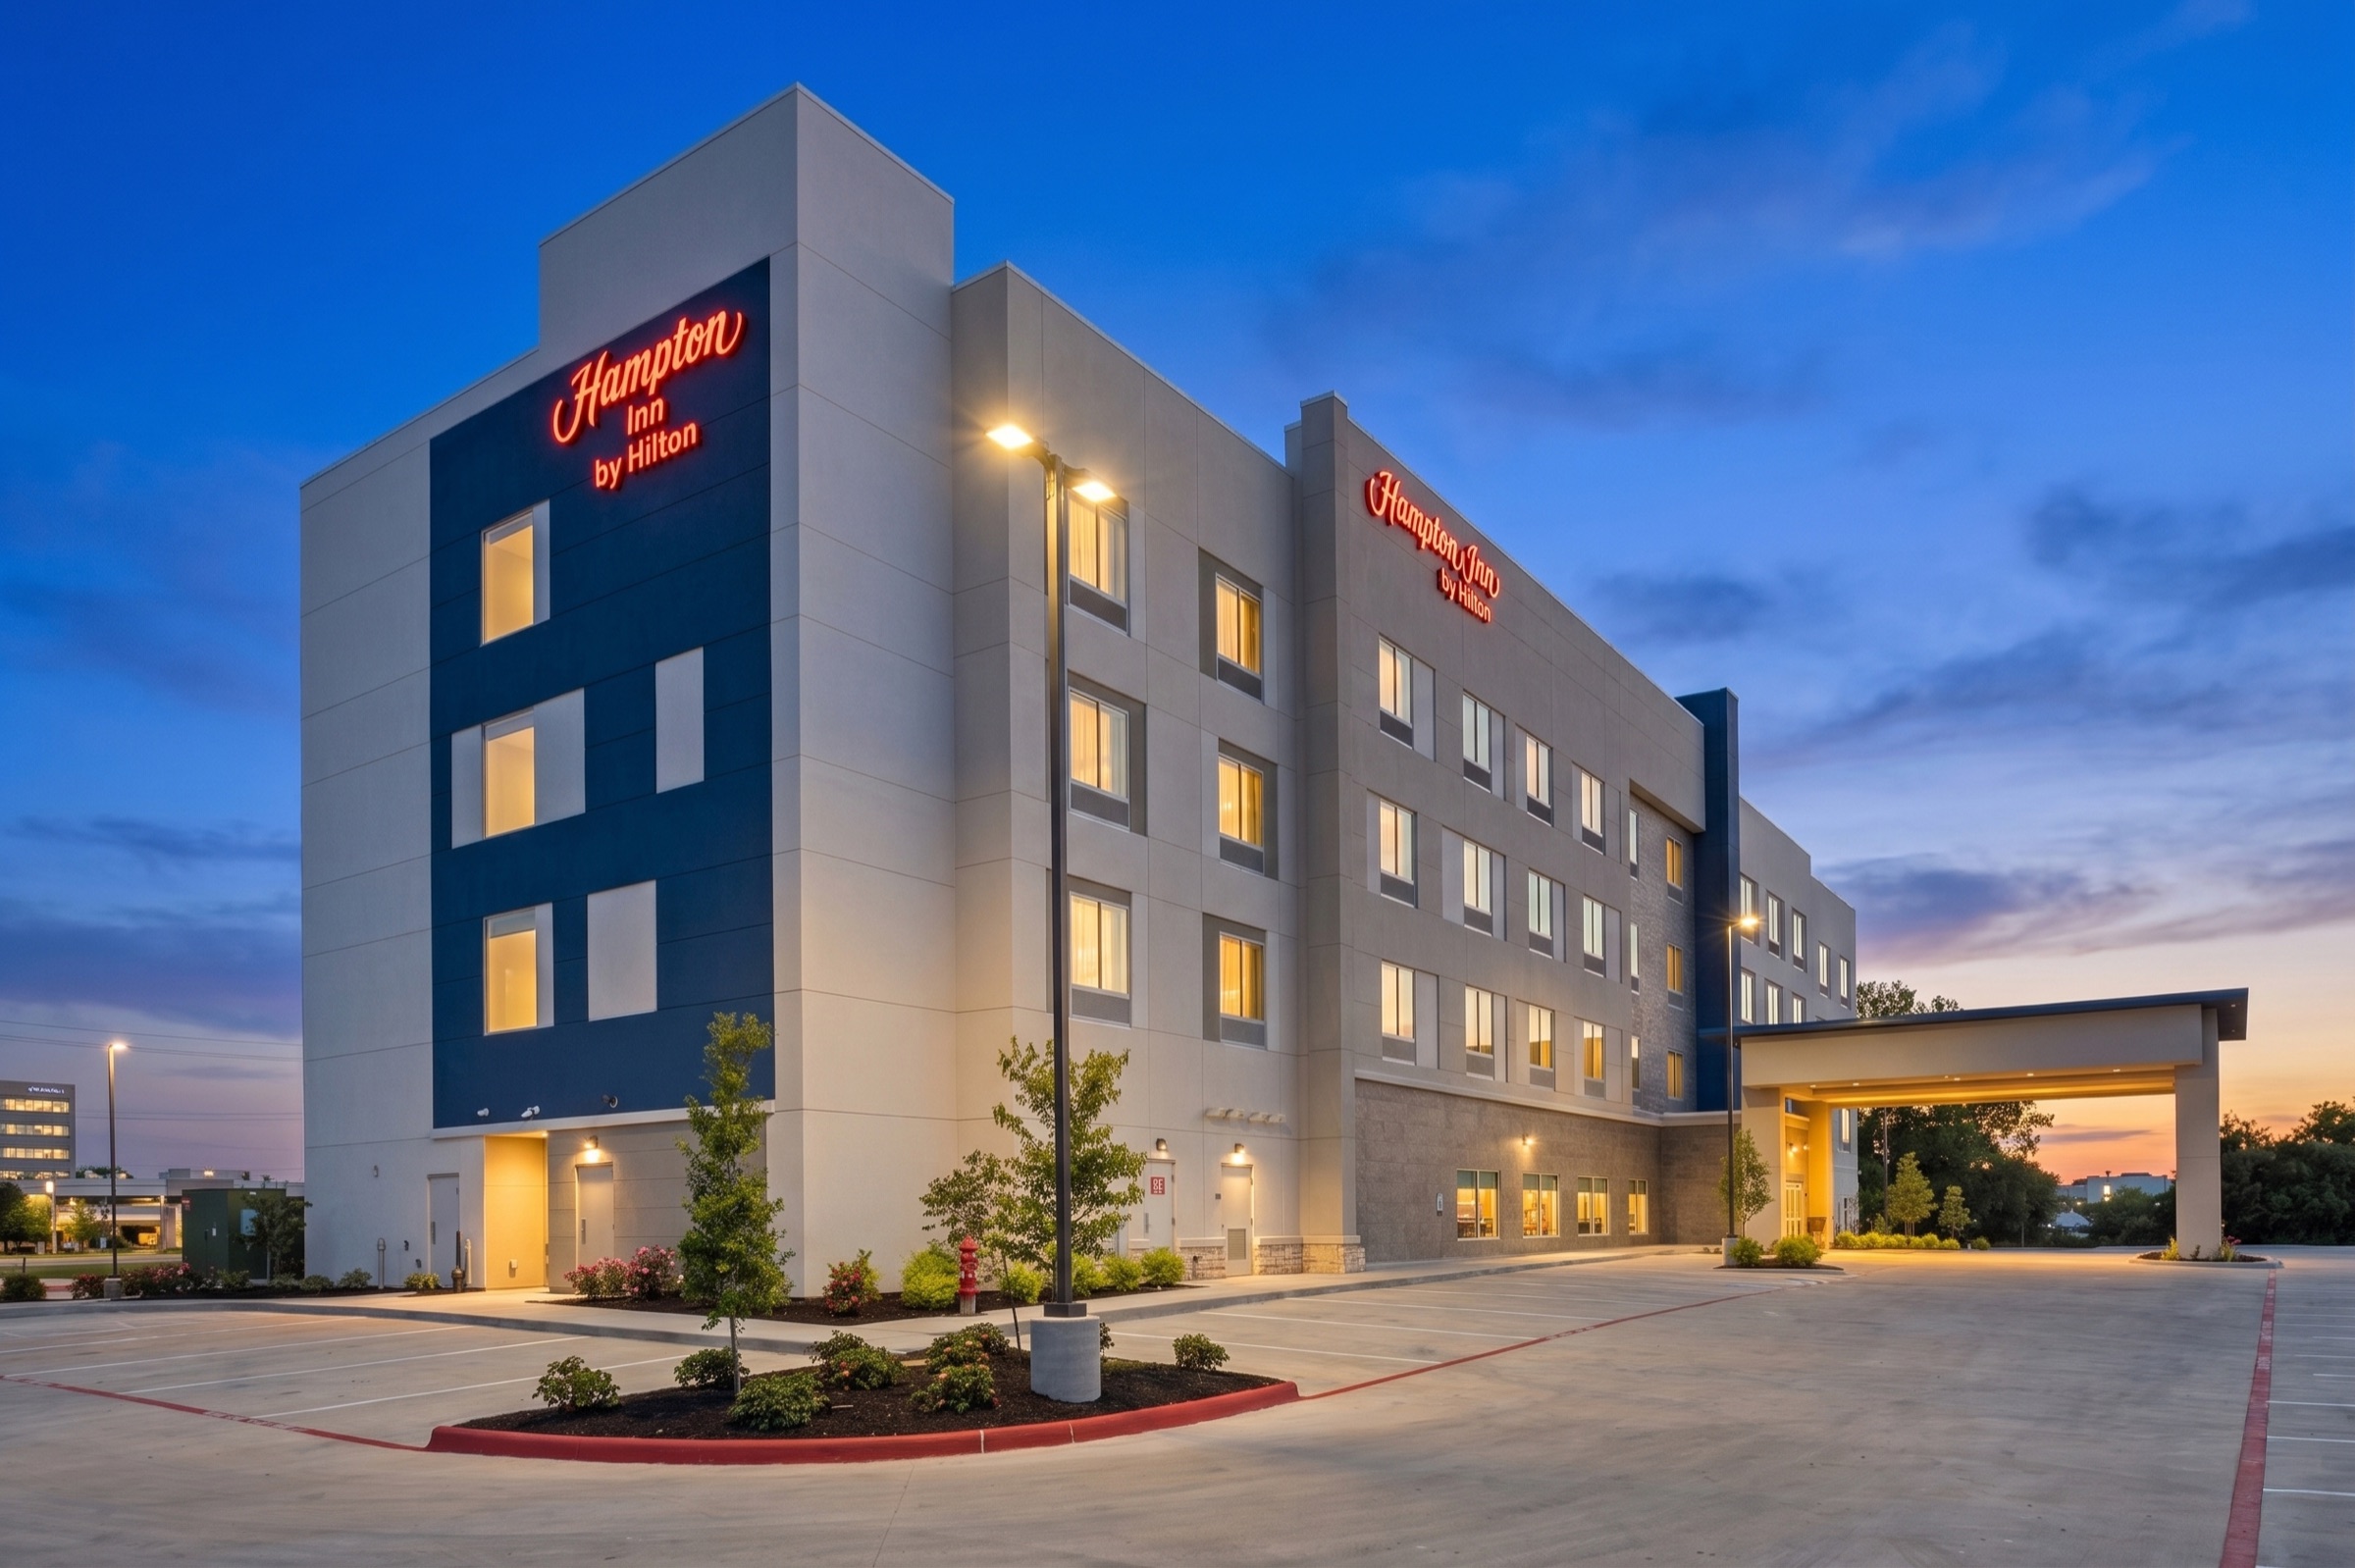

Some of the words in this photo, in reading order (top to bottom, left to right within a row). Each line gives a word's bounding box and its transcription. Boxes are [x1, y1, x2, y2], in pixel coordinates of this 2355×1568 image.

[552, 310, 744, 444] Hampton
[627, 397, 664, 436] Inn
[595, 457, 622, 490] by
[628, 423, 697, 473] Hilton
[1369, 471, 1463, 570] Hampton
[1462, 545, 1500, 599] Inn
[1441, 567, 1457, 601] by
[1459, 581, 1492, 622] Hilton
